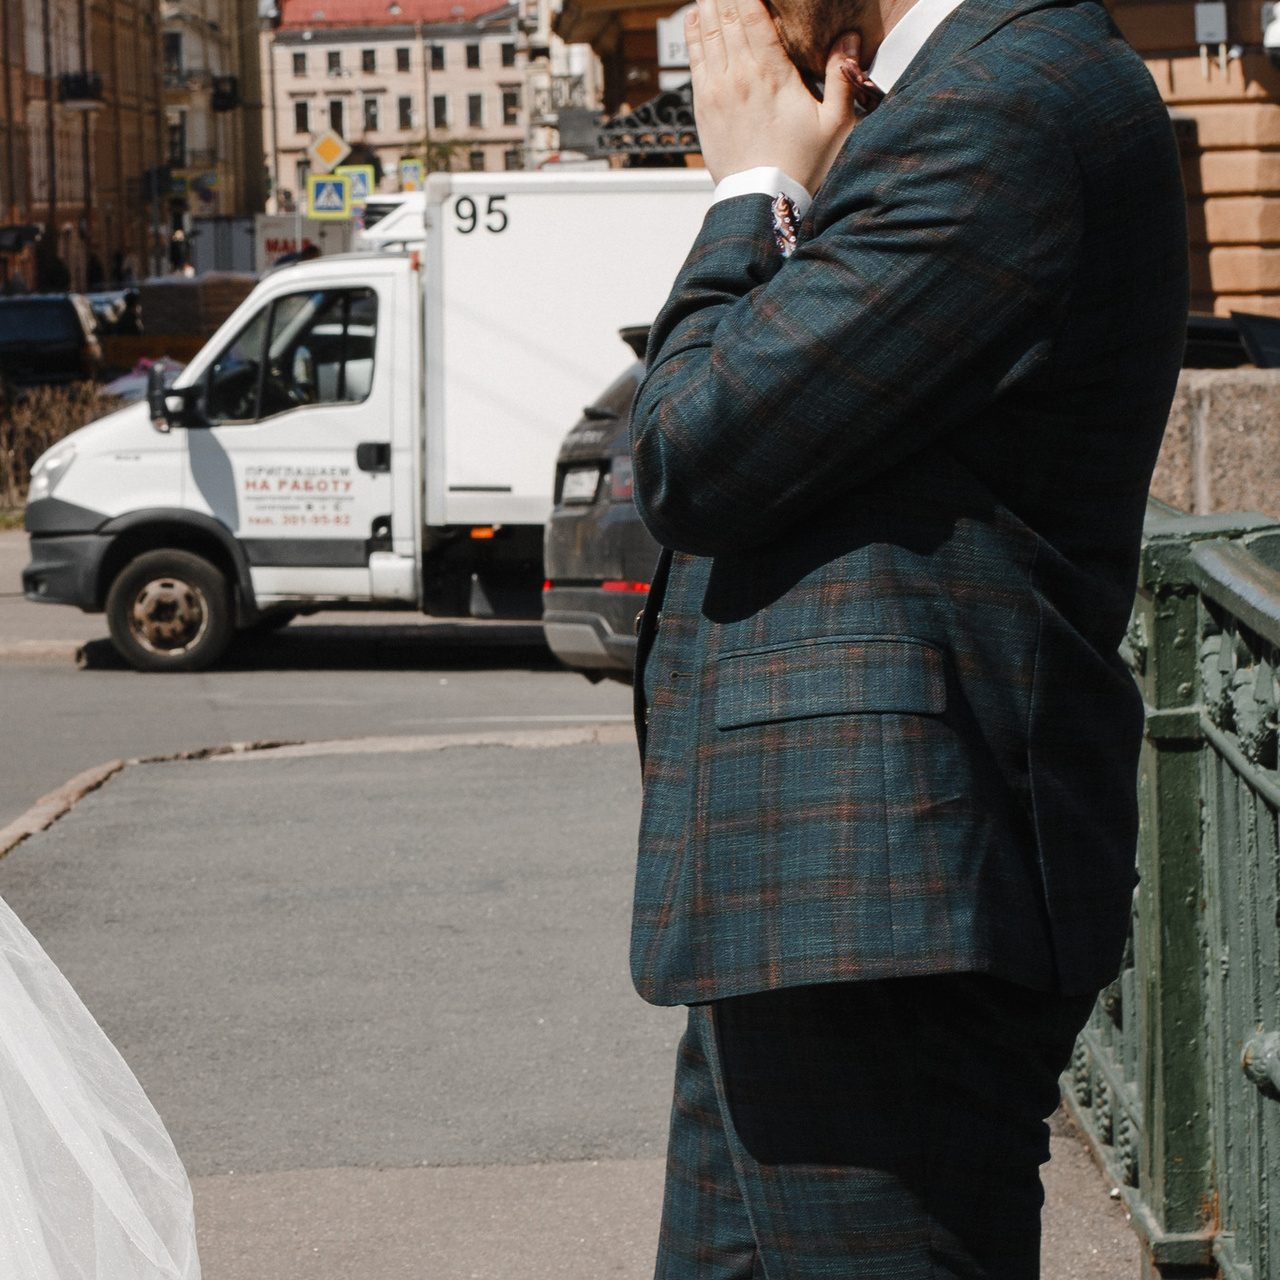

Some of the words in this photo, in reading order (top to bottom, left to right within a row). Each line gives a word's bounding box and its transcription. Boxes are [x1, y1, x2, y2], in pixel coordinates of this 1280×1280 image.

[455, 195, 508, 234] 95
[245, 466, 351, 477] ПРИГЛАШАЕМ
[245, 480, 270, 491] НА
[278, 480, 352, 491] РАБОТУ
